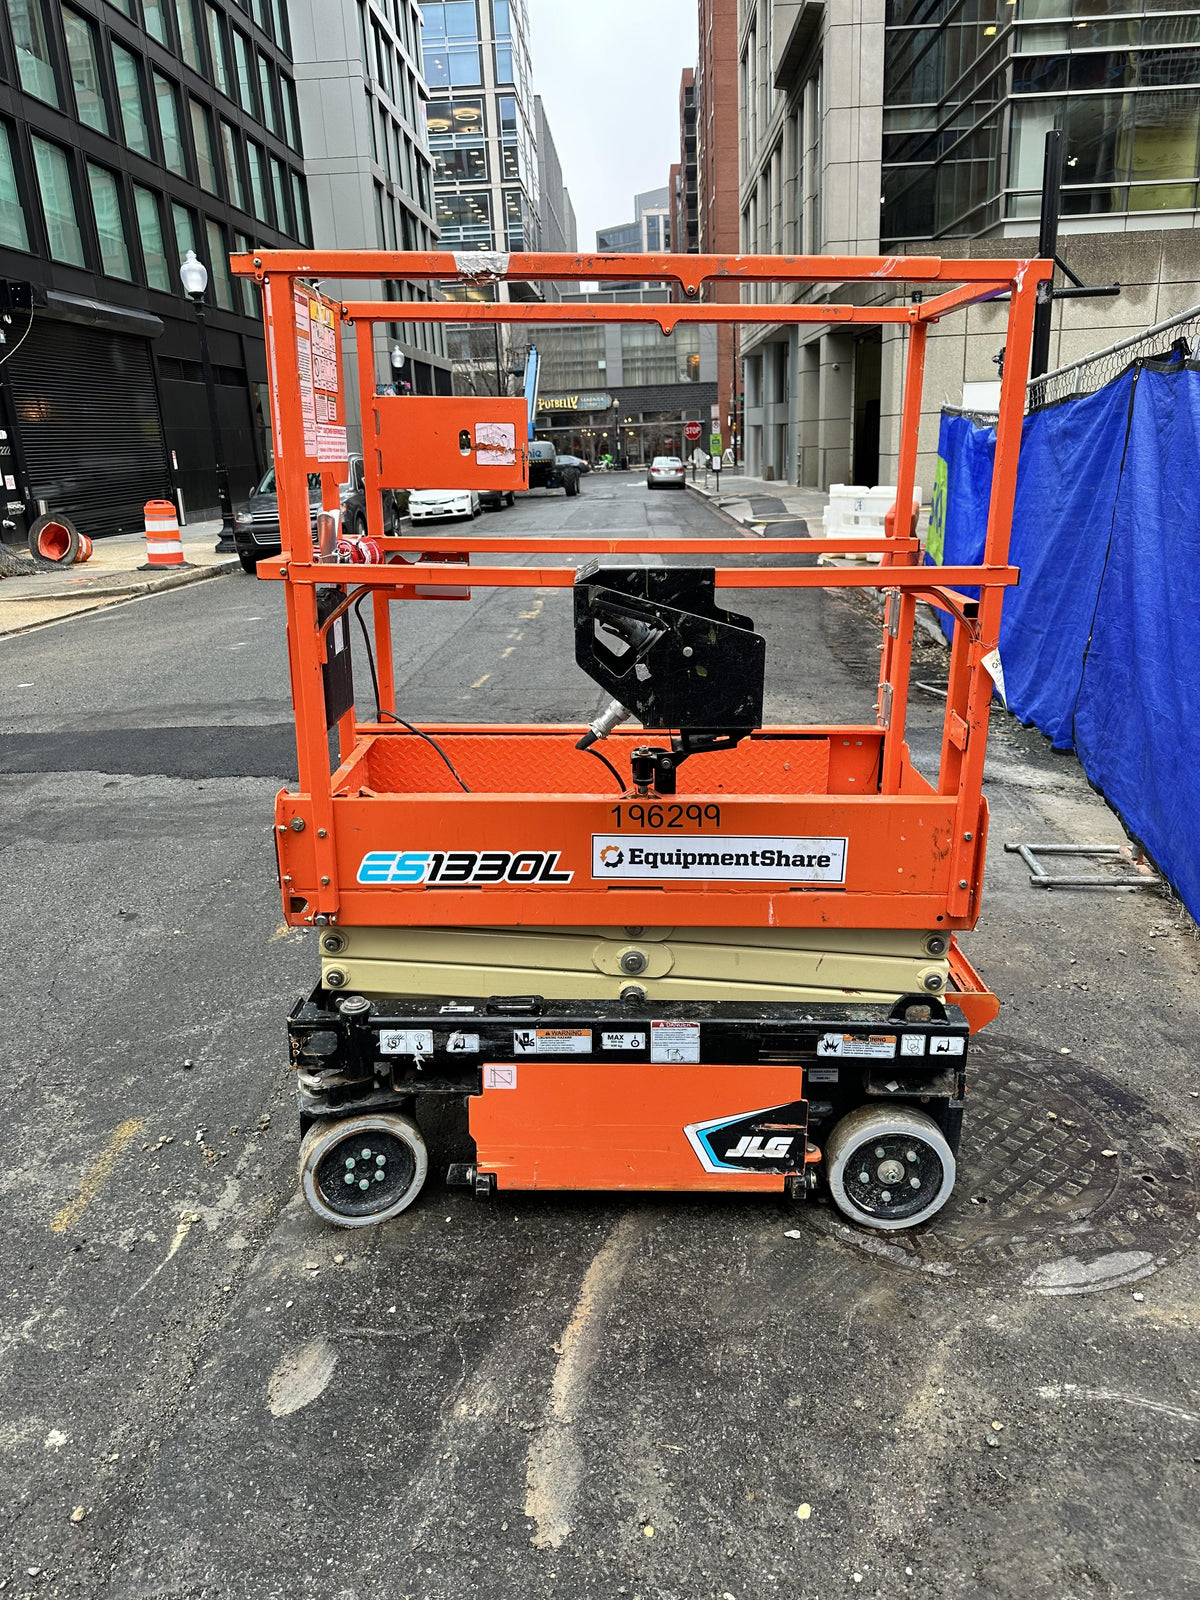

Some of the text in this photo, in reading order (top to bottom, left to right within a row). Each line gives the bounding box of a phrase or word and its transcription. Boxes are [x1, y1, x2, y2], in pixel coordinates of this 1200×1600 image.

[537, 395, 579, 411] POTBELLY
[685, 426, 701, 435] STOP
[611, 804, 721, 828] 196299
[358, 852, 573, 883] ES1330L
[628, 848, 831, 869] EquipmentShare
[724, 1136, 794, 1158] JLG
